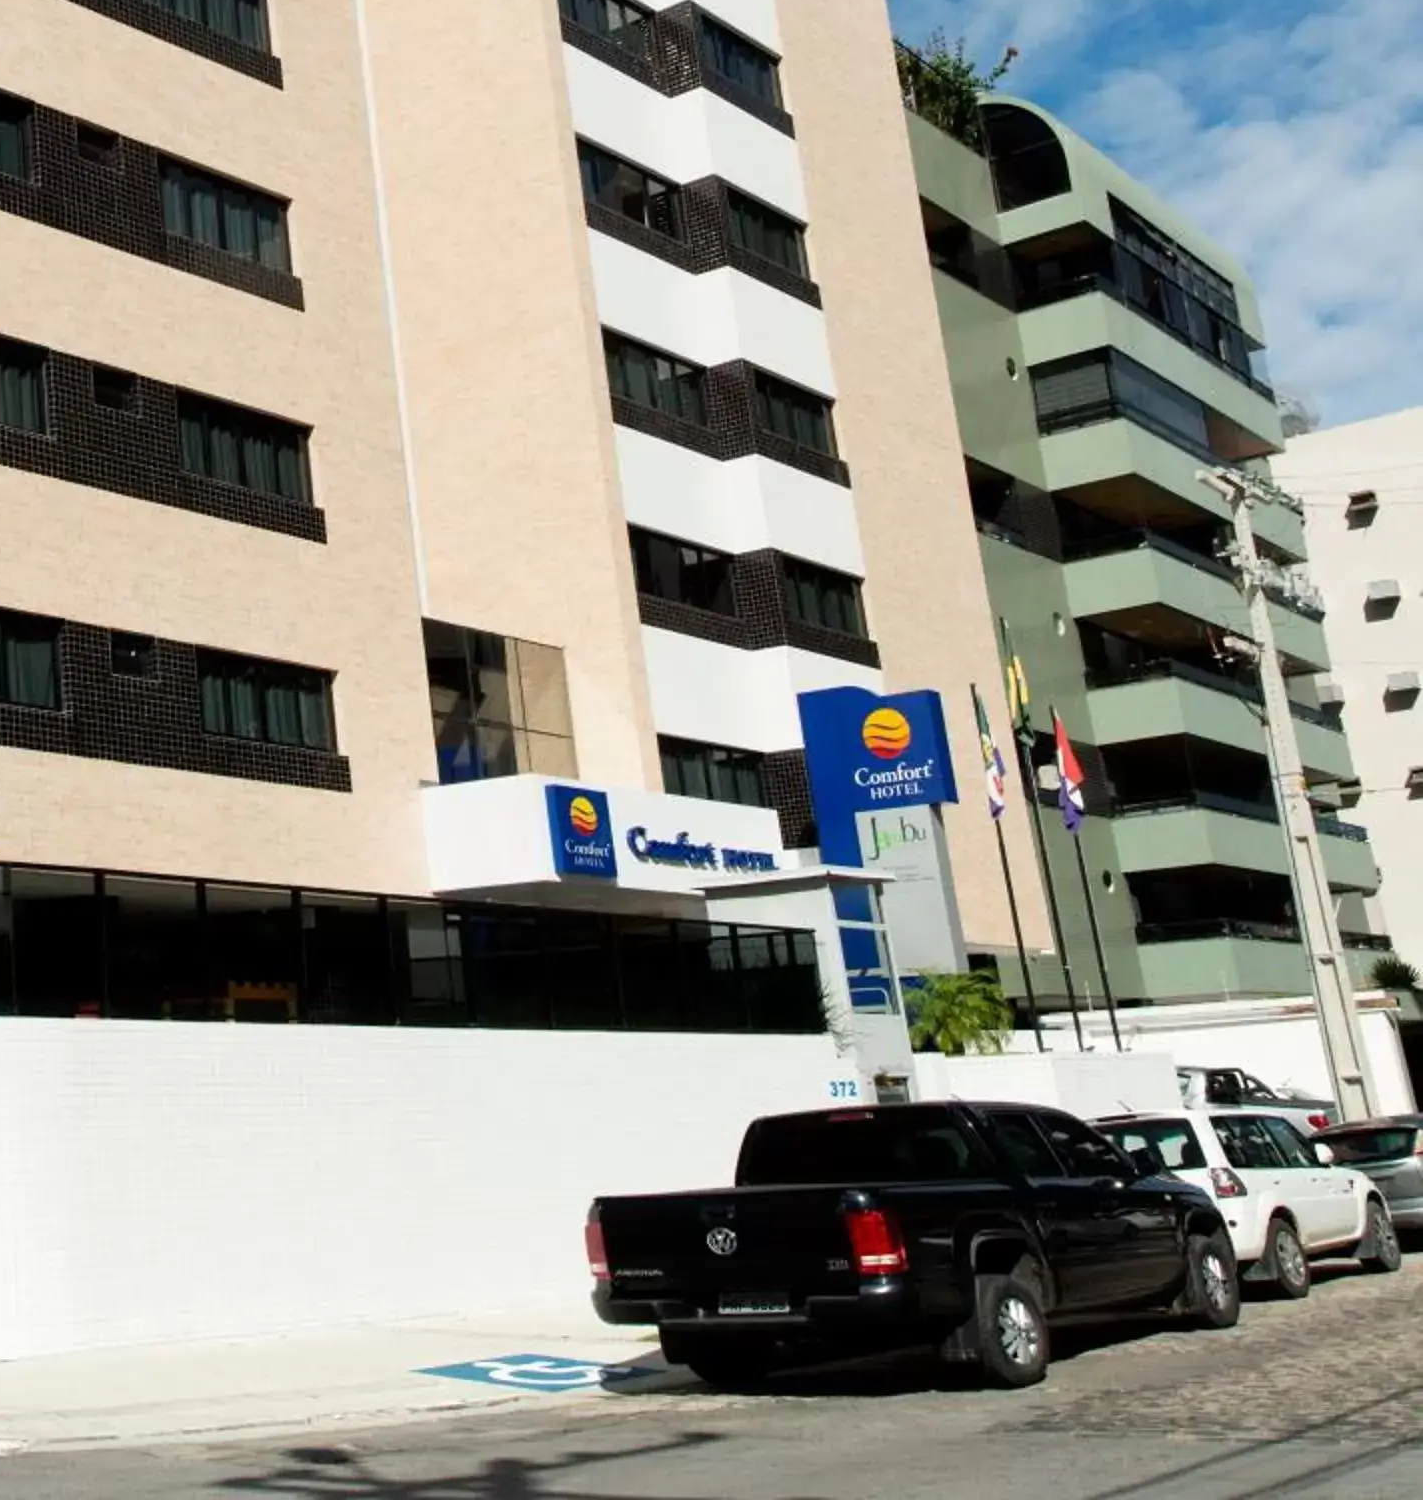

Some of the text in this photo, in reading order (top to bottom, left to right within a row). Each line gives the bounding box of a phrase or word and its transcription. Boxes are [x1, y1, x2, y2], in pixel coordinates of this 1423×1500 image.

[854, 761, 931, 787] Comfort
[870, 782, 923, 800] HOTEL
[565, 838, 609, 857] Comfort
[829, 1080, 858, 1097] 372
